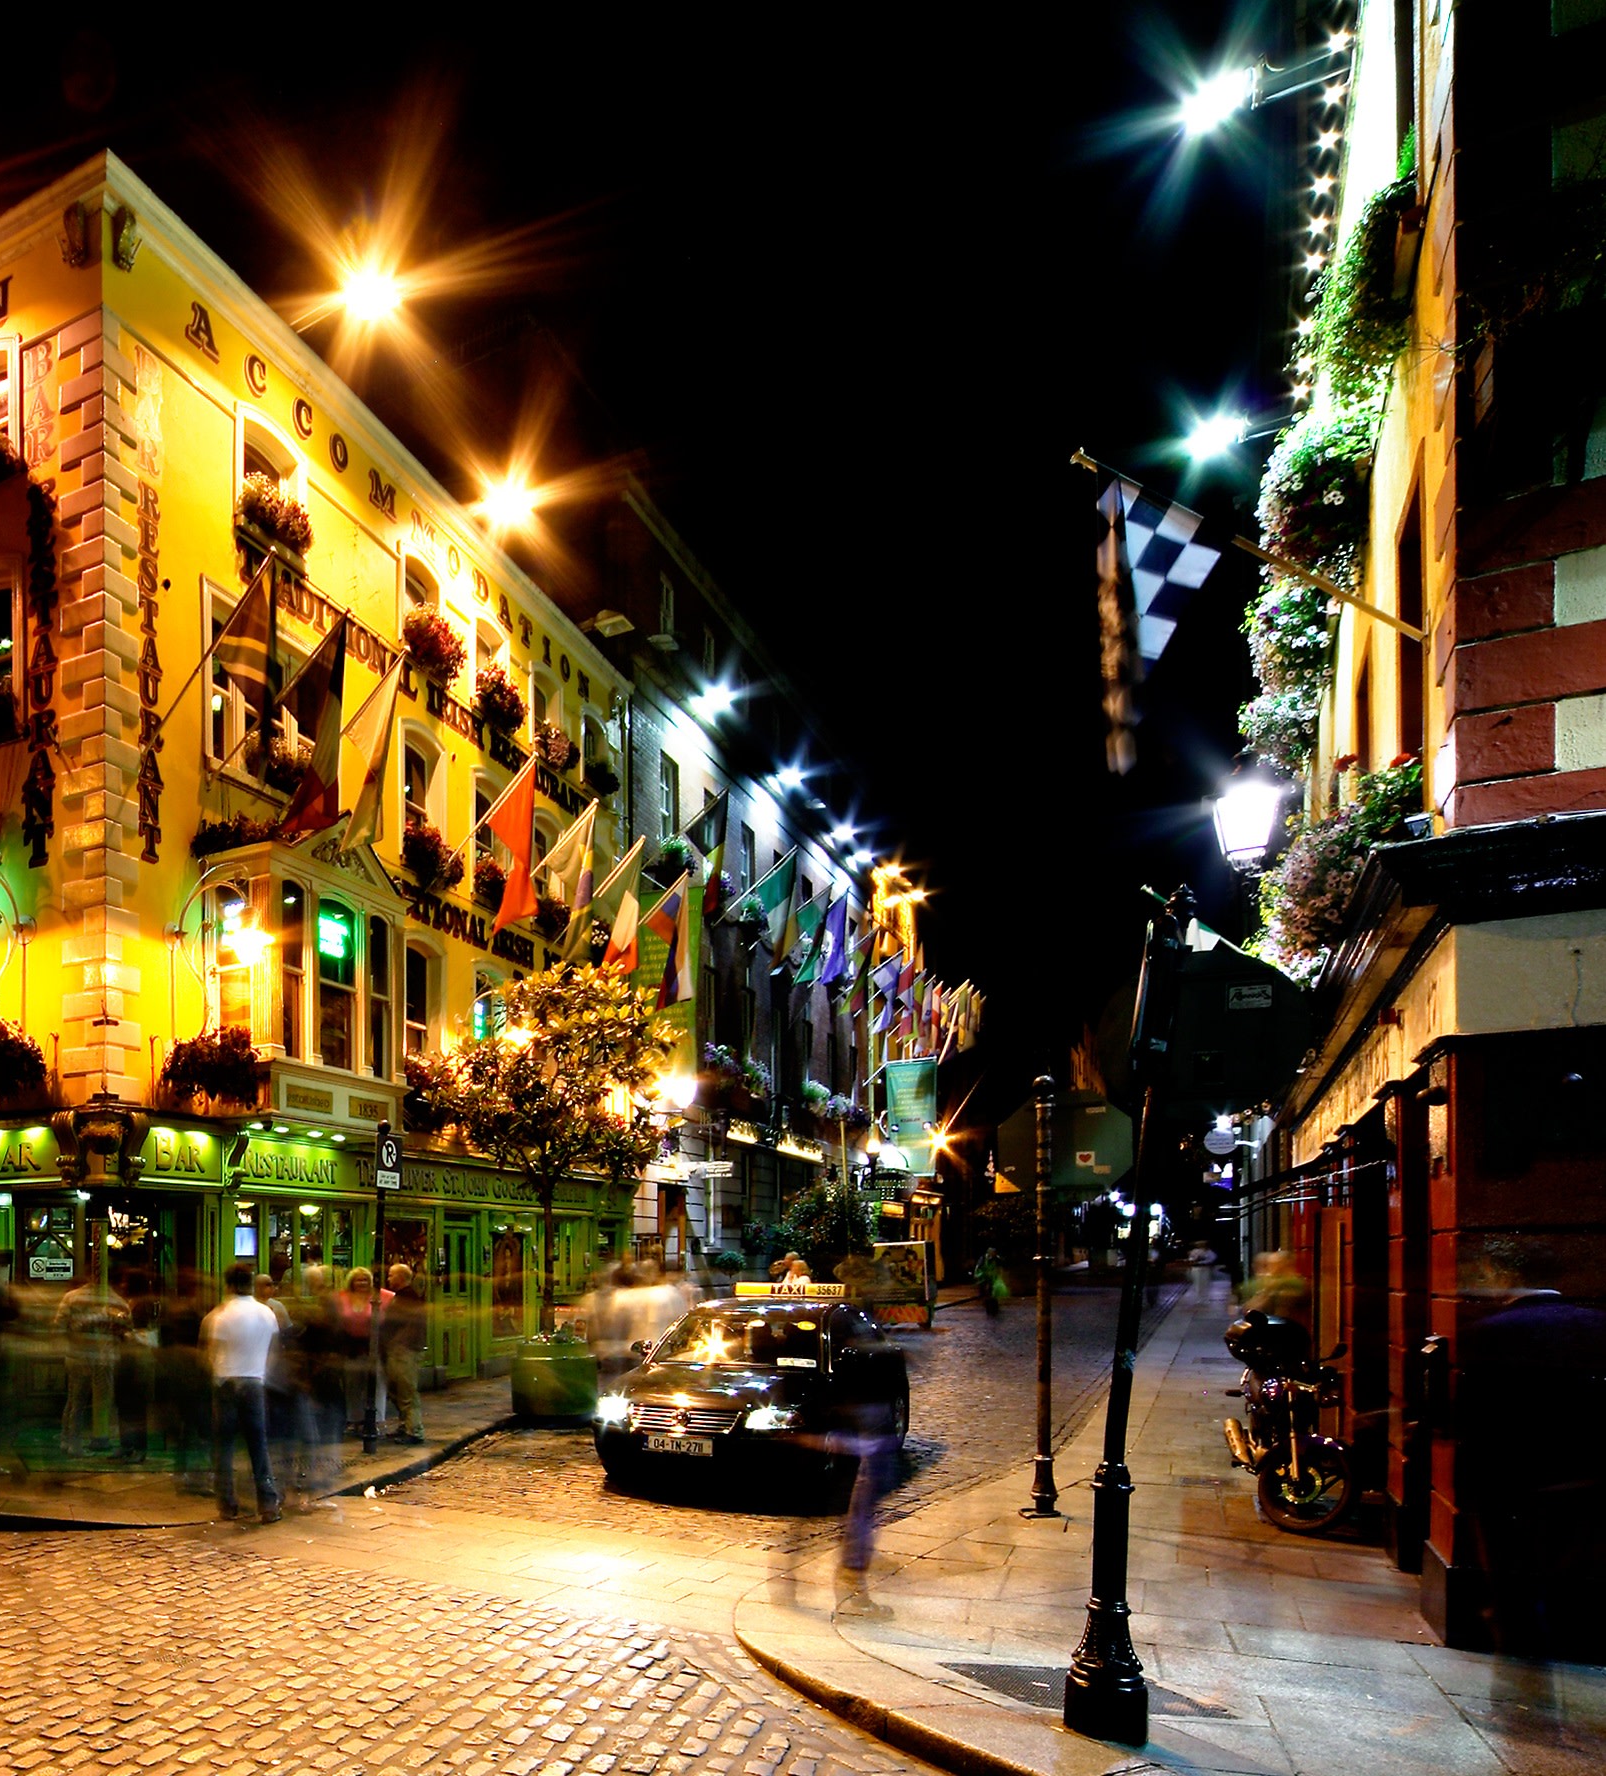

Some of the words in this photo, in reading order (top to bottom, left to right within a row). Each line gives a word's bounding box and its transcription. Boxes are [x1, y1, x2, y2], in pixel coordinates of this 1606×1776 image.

[23, 339, 57, 469] BAR
[135, 343, 162, 477] BAR
[184, 301, 591, 703] ACCOMMODATION
[21, 477, 58, 869] RESTAURANT
[136, 479, 163, 864] RESTAURANT
[426, 678, 485, 751] IRISH
[154, 1129, 206, 1174] BAR
[241, 1150, 338, 1187] RESTAURANT
[401, 1166, 438, 1194] LIVER
[772, 1284, 805, 1295] TAXI
[816, 1285, 842, 1296] 35637
